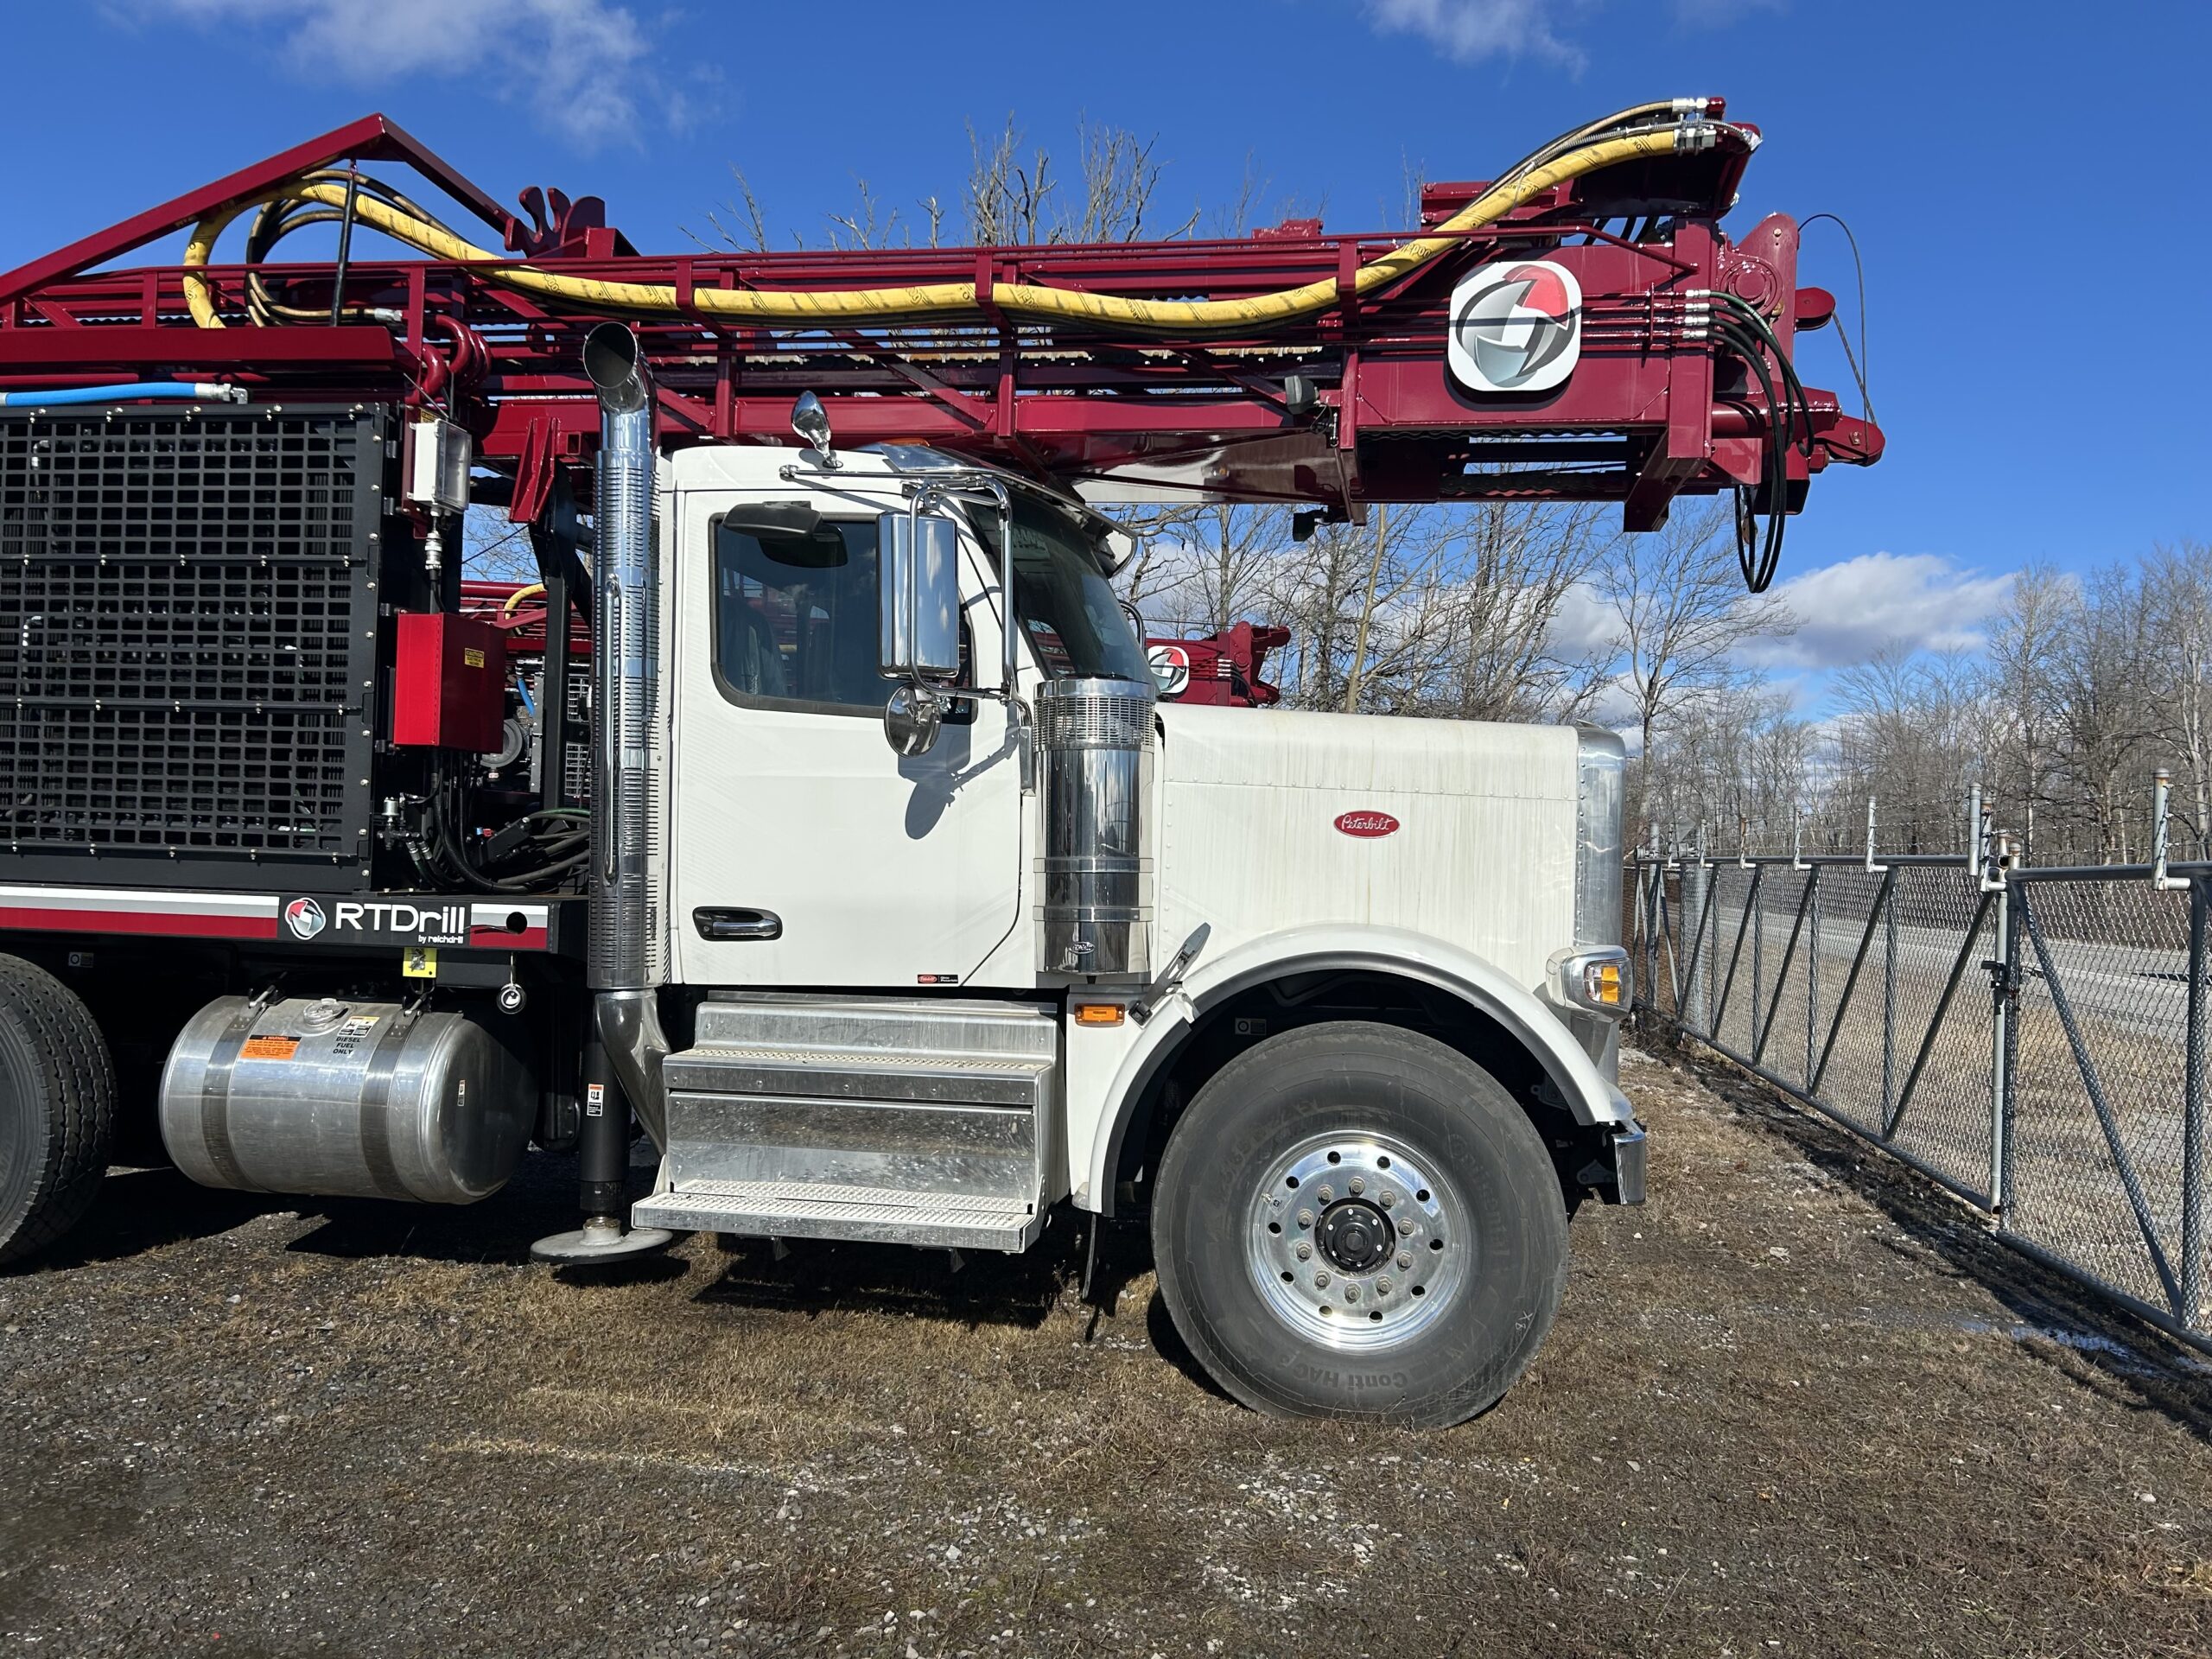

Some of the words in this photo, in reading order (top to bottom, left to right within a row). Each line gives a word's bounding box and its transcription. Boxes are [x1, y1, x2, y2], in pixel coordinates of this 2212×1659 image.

[1341, 814, 1395, 830] Peterbilt
[335, 902, 466, 934] RTDrill
[418, 934, 427, 944] by
[428, 935, 464, 944] reichdrill
[1348, 1371, 1408, 1390] Conti
